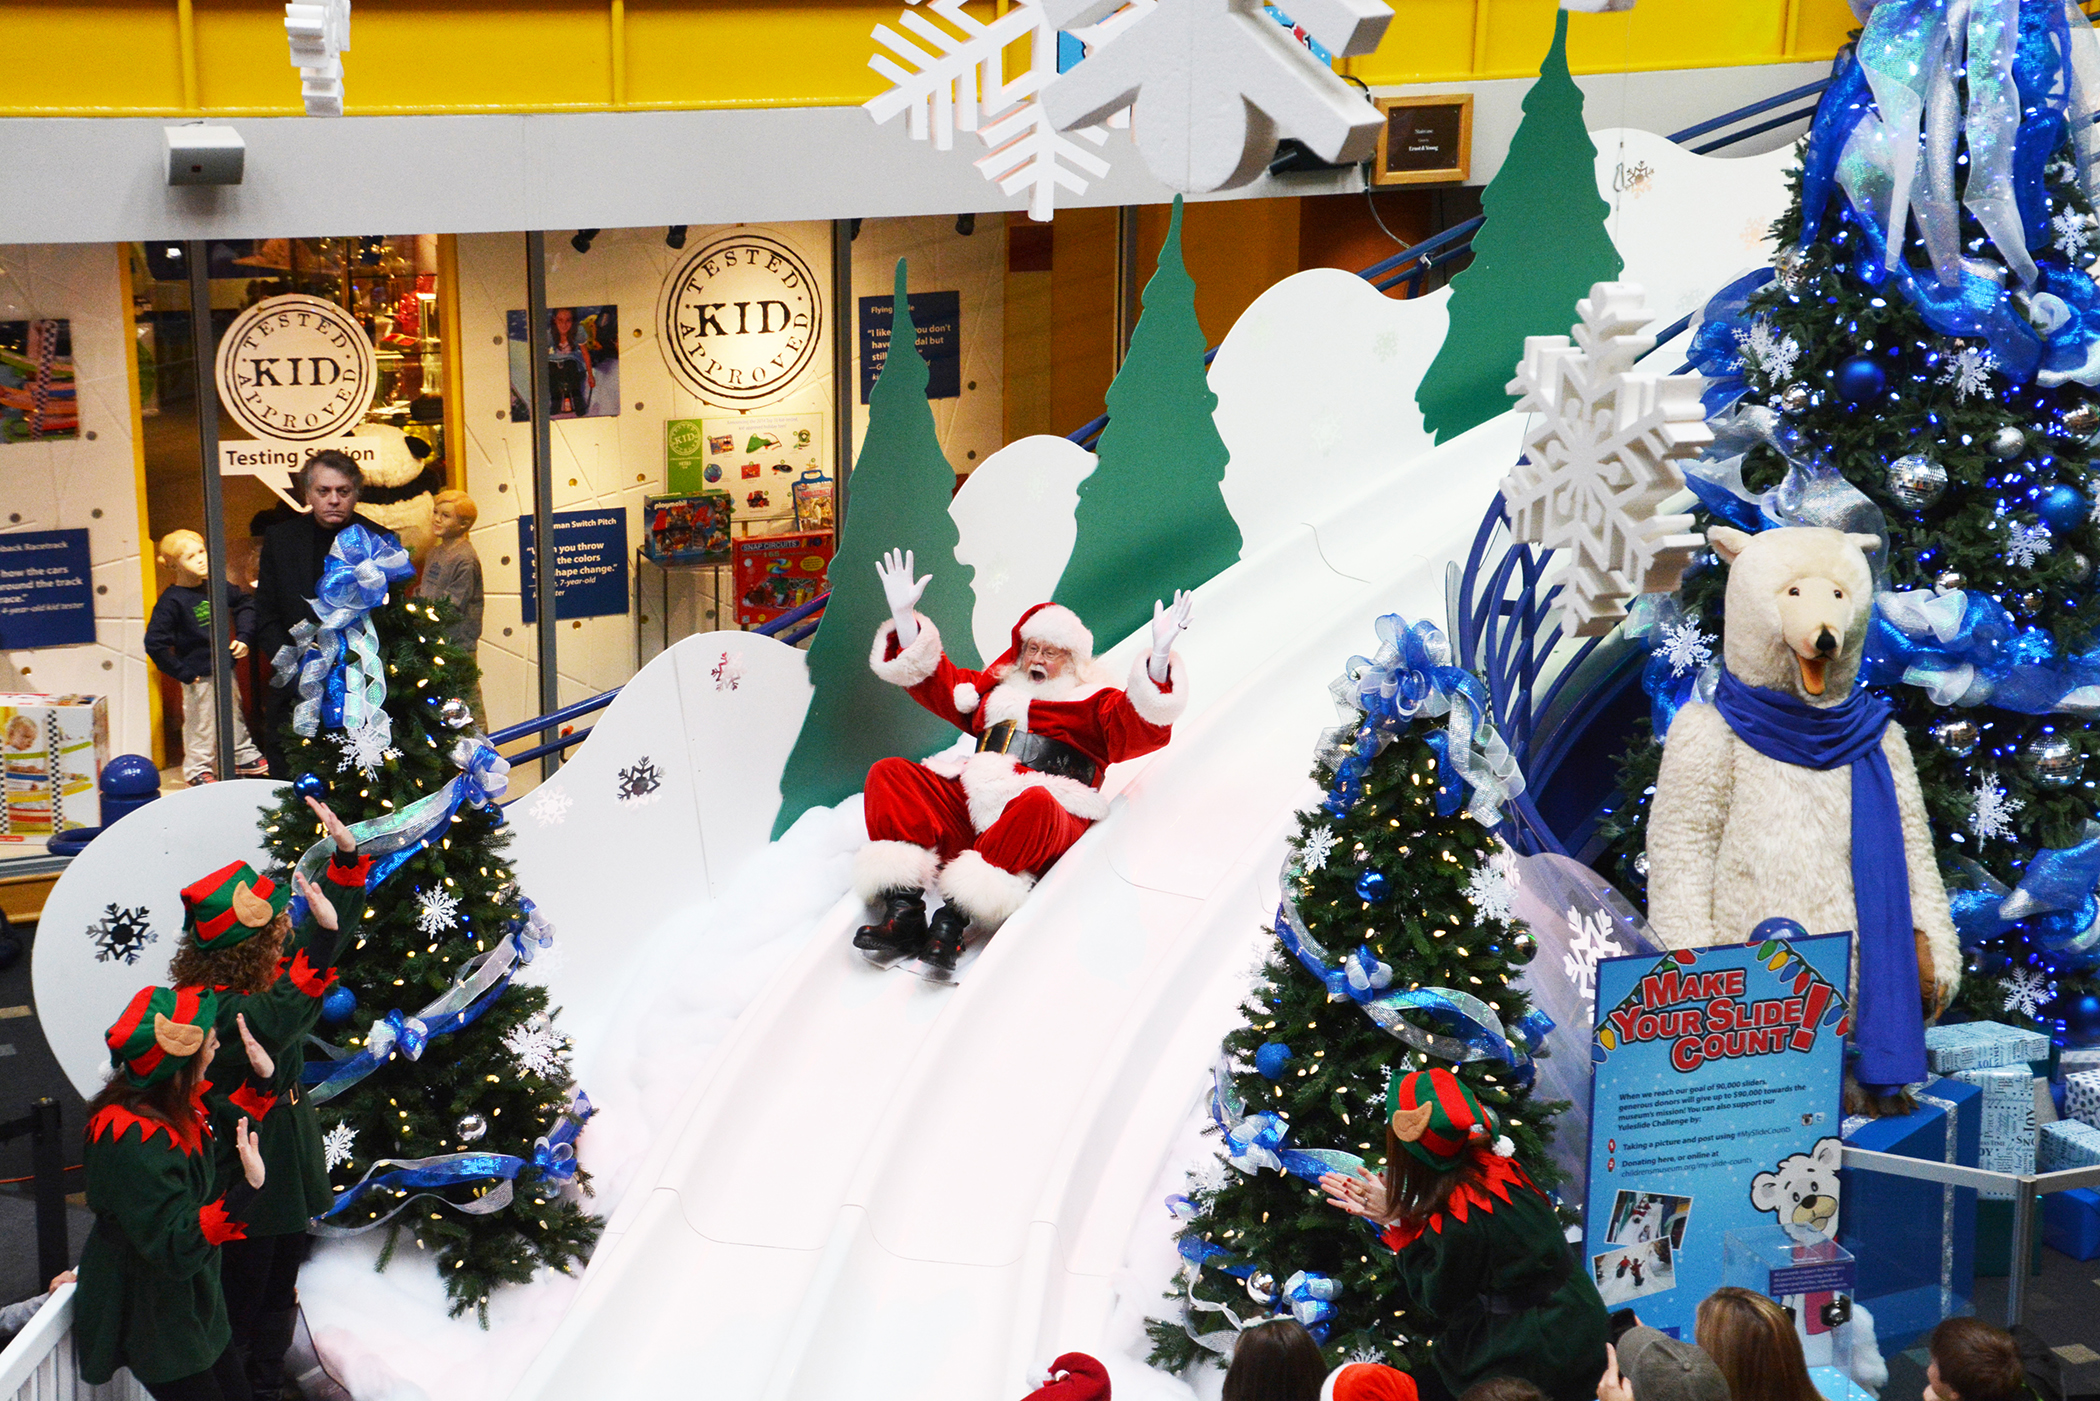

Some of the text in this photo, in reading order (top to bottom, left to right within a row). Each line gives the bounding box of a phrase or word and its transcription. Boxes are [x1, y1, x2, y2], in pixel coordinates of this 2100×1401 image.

[686, 249, 799, 294] TESTED
[870, 306, 893, 315] Flying
[693, 300, 791, 338] KID
[243, 313, 347, 350] TESTED
[876, 328, 892, 336] like
[929, 324, 951, 333] don't
[680, 312, 808, 384] APPROVED
[929, 336, 944, 345] but
[250, 357, 341, 387] KID
[237, 368, 356, 428] APPROVED
[674, 432, 695, 444] KID
[226, 446, 374, 468] Testing Sion
[654, 500, 688, 510] playmobil
[572, 519, 596, 528] Switch
[598, 518, 617, 526] Pitch
[24, 541, 69, 550] Racetrack
[558, 546, 576, 554] you
[577, 542, 604, 551] throw
[764, 540, 797, 549] CIRCUITS
[556, 554, 601, 564] the colors
[26, 567, 44, 576] the
[46, 566, 69, 575] cars
[36, 580, 54, 588] the
[56, 576, 83, 586] track
[560, 576, 596, 588] 7-year-old
[1642, 970, 1744, 1010] MAKE
[1610, 998, 1803, 1043] YOUR SLIDE
[1618, 1103, 1653, 1112] generous
[1682, 1096, 1695, 1104] will
[1696, 1096, 1712, 1104] give
[1734, 1088, 1762, 1098] $90,000
[1764, 1086, 1792, 1094] towards
[1619, 1093, 1640, 1101] When
[1654, 1088, 1674, 1097] reach
[1690, 1085, 1706, 1094] goal
[1716, 1081, 1741, 1090] 90,000
[1618, 1111, 1654, 1121] museum's
[1656, 1108, 1686, 1117] mission!
[1733, 1100, 1762, 1108] support
[1618, 1122, 1650, 1131] Yuleslide
[1652, 1117, 1688, 1128] Challenge
[2024, 1106, 2035, 1132] JOY
[1623, 1142, 1648, 1151] Taking
[1655, 1139, 1680, 1148] picture
[1682, 1136, 1696, 1144] and
[1716, 1132, 1735, 1140] using
[1737, 1126, 1792, 1138] #MySlideCounts
[1622, 1158, 1656, 1168] Donating
[1658, 1156, 1676, 1164] here,
[1687, 1152, 1710, 1160] online
